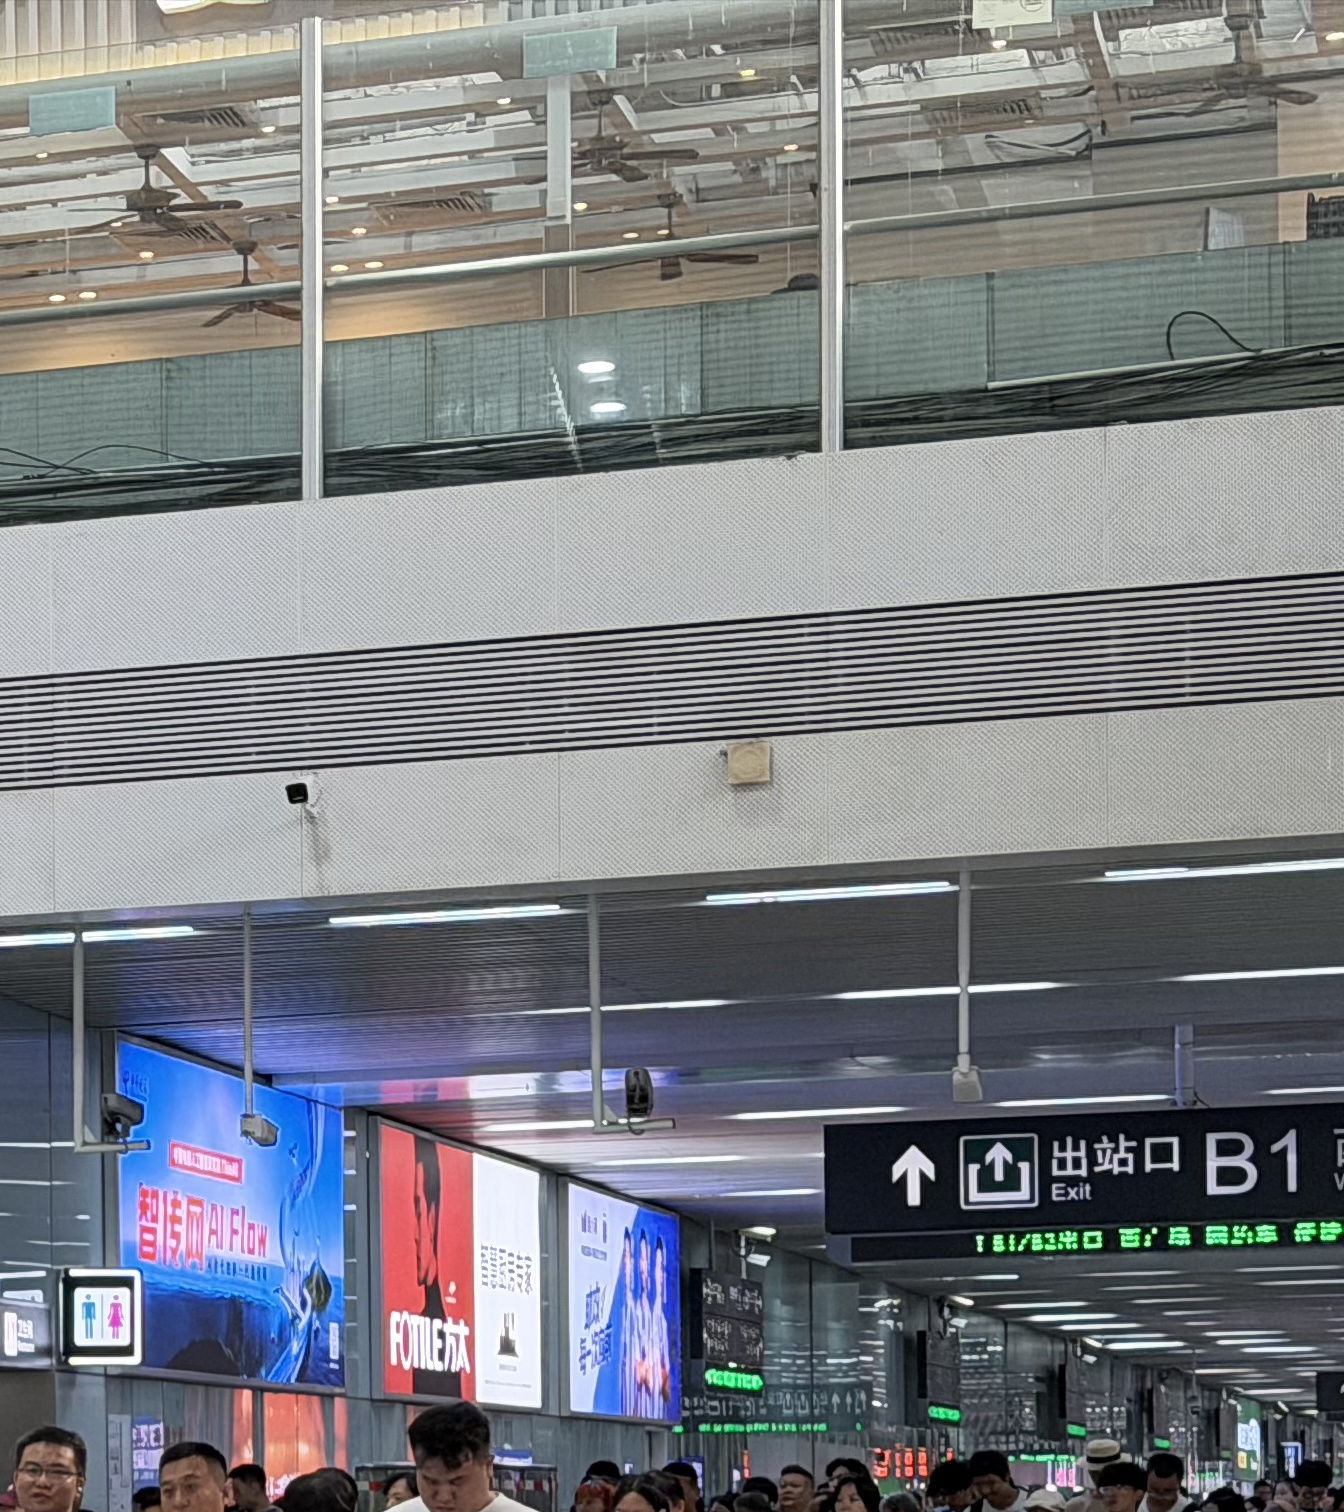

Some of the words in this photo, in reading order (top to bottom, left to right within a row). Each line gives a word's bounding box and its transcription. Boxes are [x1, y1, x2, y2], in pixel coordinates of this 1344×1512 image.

[1051, 1133, 1180, 1178] 出站口
[1206, 1129, 1298, 1195] B1
[1052, 1183, 1092, 1201] Exit
[139, 1183, 205, 1271] 智传网
[208, 1203, 224, 1250] AI
[229, 1205, 268, 1258] Flow
[390, 1311, 444, 1372] FOTILE
